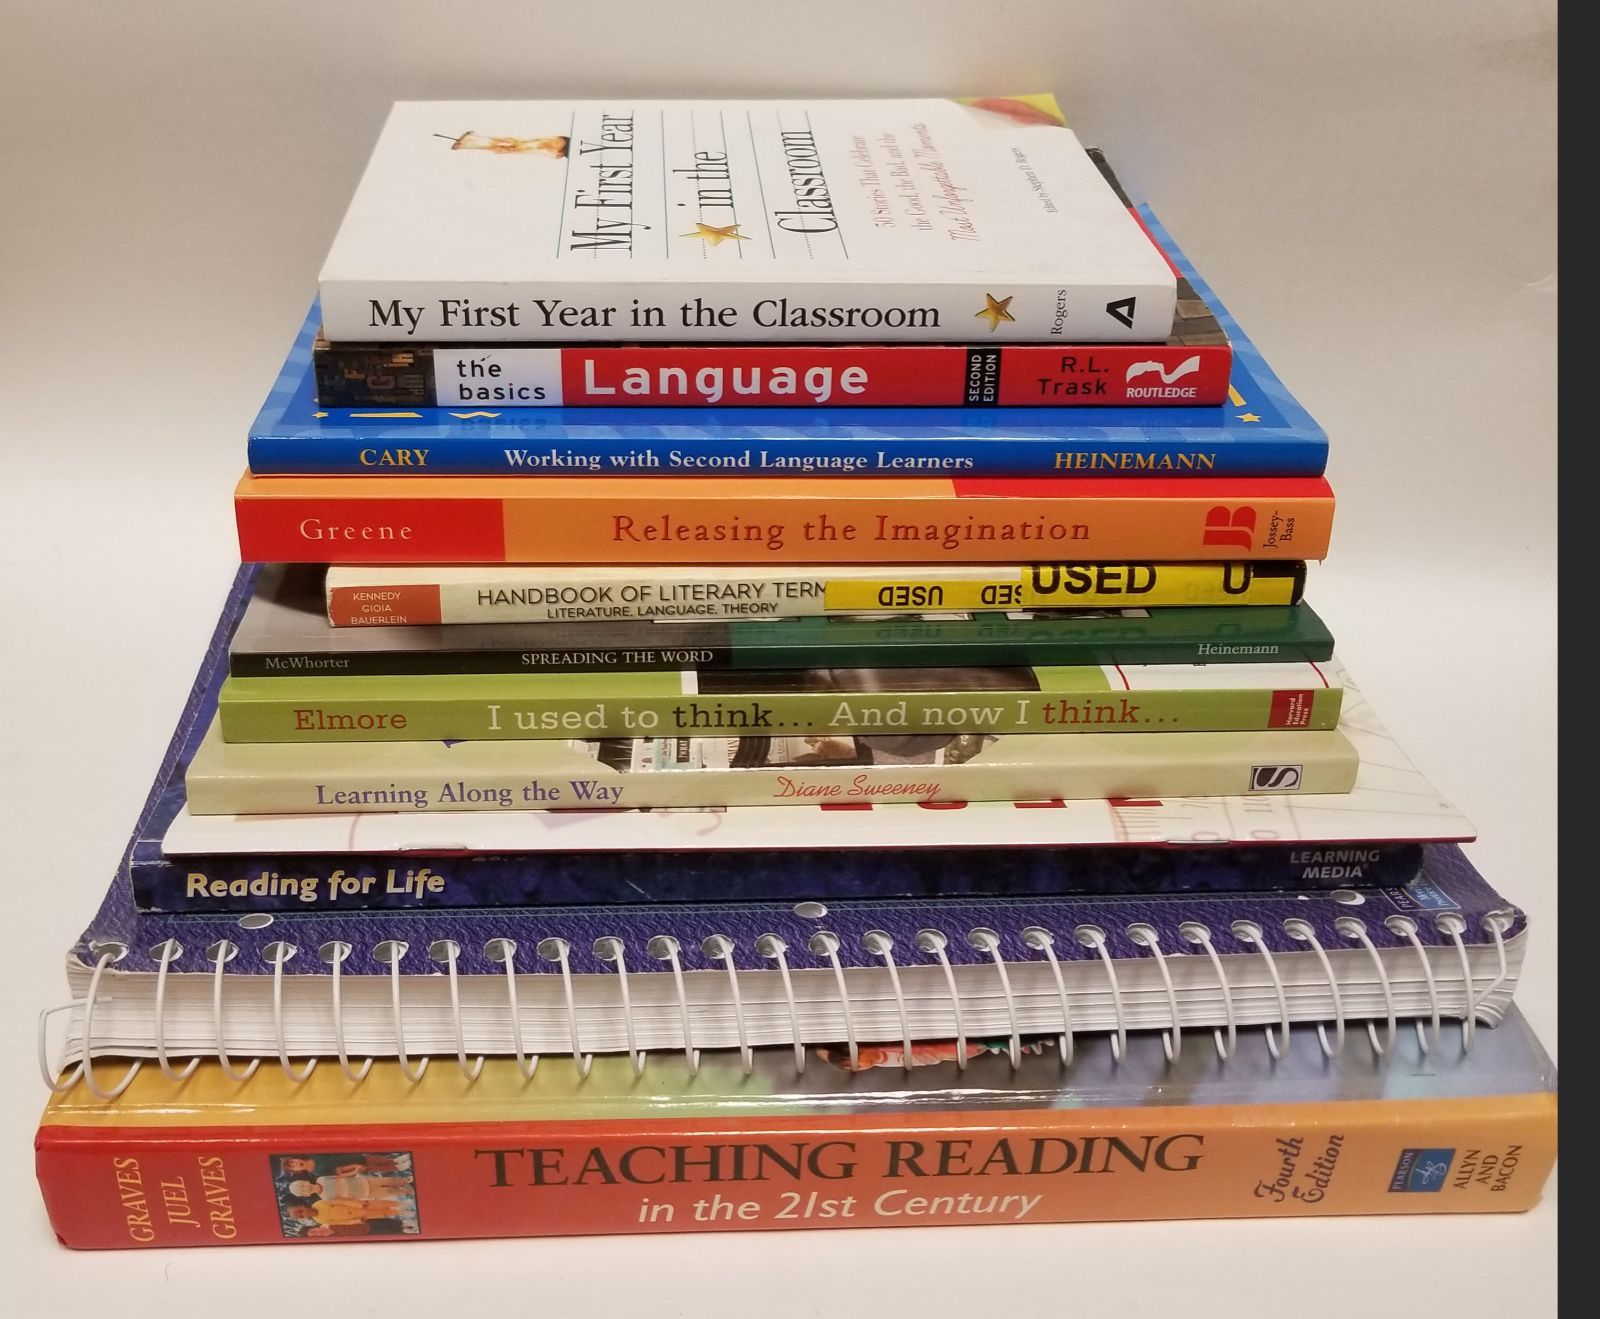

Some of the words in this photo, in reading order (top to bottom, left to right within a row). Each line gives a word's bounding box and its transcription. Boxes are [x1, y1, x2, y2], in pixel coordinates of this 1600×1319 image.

[579, 114, 633, 156] Year
[672, 151, 730, 180] the
[574, 163, 633, 209] First
[774, 131, 839, 233] Classroom
[677, 188, 734, 209] in
[867, 188, 892, 215] Stories
[571, 217, 651, 251] My
[369, 300, 425, 335] My
[439, 299, 520, 327] First
[532, 300, 616, 327] Year
[629, 299, 665, 327] in
[680, 298, 738, 327] the
[752, 298, 940, 328] Classroom
[1050, 289, 1068, 335] Rogers
[457, 359, 502, 378] the
[969, 354, 982, 402] SECOND
[983, 354, 997, 402] EDITION
[1061, 357, 1109, 373] R.L.
[459, 383, 546, 401] basics
[584, 359, 869, 403] Language
[1038, 378, 1107, 395] Trask
[1126, 387, 1197, 398] ROUTLEDGE
[359, 449, 430, 467] CARY
[504, 449, 601, 470] Working
[609, 450, 660, 467] with
[669, 449, 751, 469] Second
[760, 451, 868, 472] Language
[877, 452, 974, 469] Learners
[1055, 452, 1216, 470] HEINEMANN
[300, 519, 414, 542] Greene
[612, 514, 785, 551] Releasing
[803, 514, 857, 541] the
[874, 514, 1091, 550] Imagination
[1263, 511, 1284, 549] Jossey-
[1280, 517, 1295, 541] Bass
[1031, 562, 1157, 595] USED
[353, 592, 401, 602] KENNEDY
[478, 586, 613, 606] HANDBOOK
[620, 585, 651, 602] OF
[659, 582, 766, 602] LITERARY
[722, 602, 778, 614] THEORY
[878, 585, 944, 606] USED
[351, 615, 407, 625] BAUERLEIN
[362, 604, 392, 613] GIOIA
[265, 657, 350, 669] McWhorter
[521, 651, 617, 666] SPREADING
[622, 651, 656, 663] THE
[661, 650, 713, 663] WORD
[1198, 643, 1279, 655] Heinemann
[294, 709, 408, 730] Elmore
[488, 705, 502, 730] I
[514, 704, 608, 730] used
[620, 706, 659, 729] to
[673, 703, 813, 729] think...
[828, 701, 908, 727] And
[922, 706, 1004, 726] now
[1015, 700, 1031, 725] I
[1042, 698, 1178, 724] think...
[1285, 697, 1296, 725] Harvard
[1292, 693, 1304, 725] Education
[1300, 707, 1309, 725] Press
[315, 783, 428, 808] Learning
[438, 782, 513, 807] Along
[522, 780, 560, 801] the
[569, 780, 624, 805] Way
[773, 776, 842, 798] Diane
[847, 774, 941, 800] Sweeney
[1290, 849, 1380, 863] LEARNING
[187, 872, 319, 902] Reading
[328, 870, 376, 900] for
[386, 868, 445, 899] Life
[474, 1141, 858, 1188] TEACHING
[882, 1134, 1204, 1178] READING
[1254, 1135, 1303, 1203] Fourth
[1292, 1134, 1345, 1203] Edition
[1392, 1151, 1414, 1190] PEARSON
[1453, 1149, 1481, 1189] ALLYN
[1475, 1154, 1499, 1184] AND
[1490, 1145, 1523, 1192] BACON
[113, 1157, 155, 1242] GRAVES
[160, 1176, 200, 1228] JUEL
[198, 1156, 237, 1239] GRAVES
[638, 1198, 675, 1223] in
[693, 1194, 760, 1221] the
[774, 1191, 857, 1219] 21st
[873, 1189, 1043, 1219] Century
